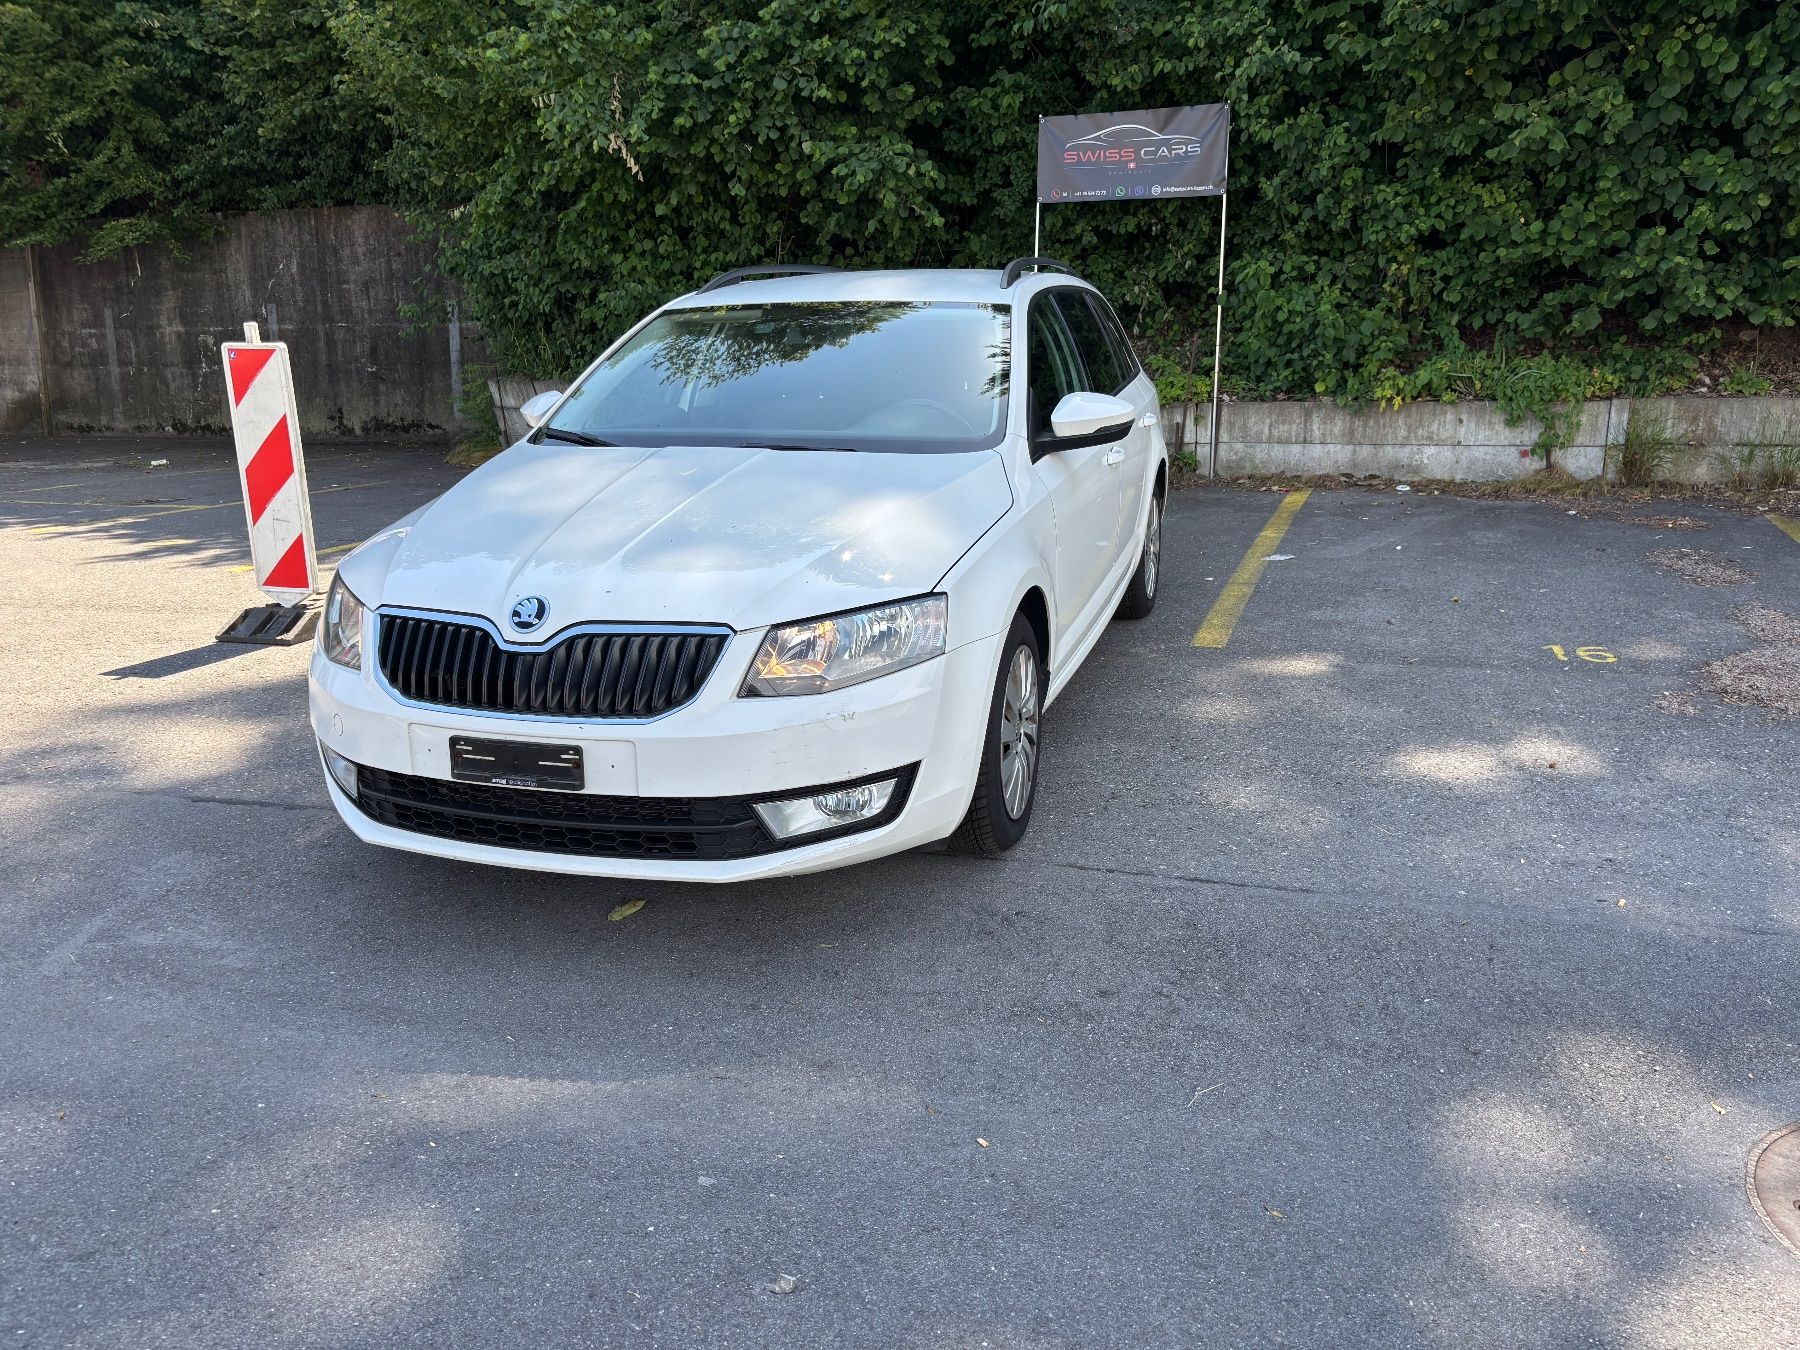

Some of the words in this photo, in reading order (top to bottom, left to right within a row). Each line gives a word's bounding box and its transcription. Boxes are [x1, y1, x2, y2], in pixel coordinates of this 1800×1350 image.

[1064, 149, 1135, 163] SWISS
[1140, 143, 1201, 159] CARS
[1541, 643, 1618, 663] 16
